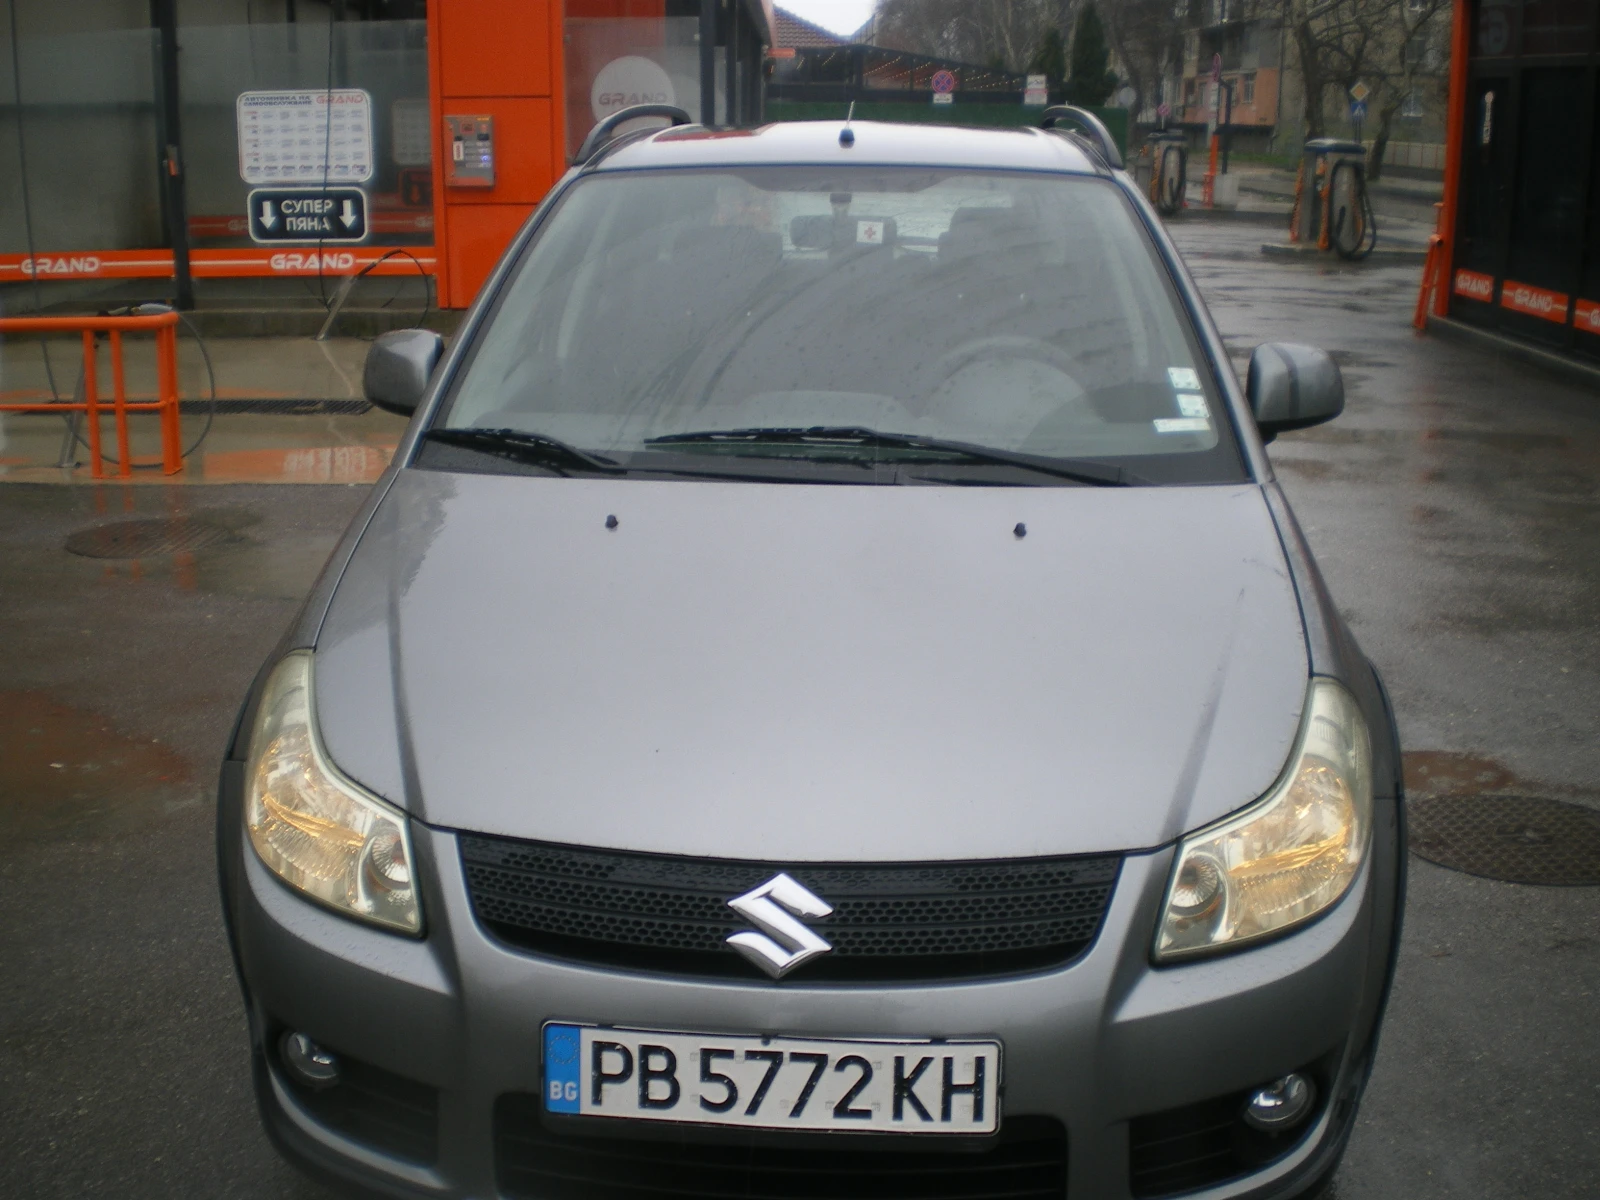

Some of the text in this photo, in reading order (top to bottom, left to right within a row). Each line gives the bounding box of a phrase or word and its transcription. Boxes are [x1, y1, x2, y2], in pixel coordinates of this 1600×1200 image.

[598, 92, 668, 106] GRAND
[281, 199, 334, 214] СУПЕР
[286, 216, 332, 231] ПЯНА
[20, 256, 100, 274] GRAND
[269, 253, 354, 270] GRAND
[1457, 273, 1490, 296] GRAND
[1514, 287, 1553, 312] GRAND
[549, 1080, 578, 1101] BG
[590, 1040, 987, 1123] PB 5772 KH
